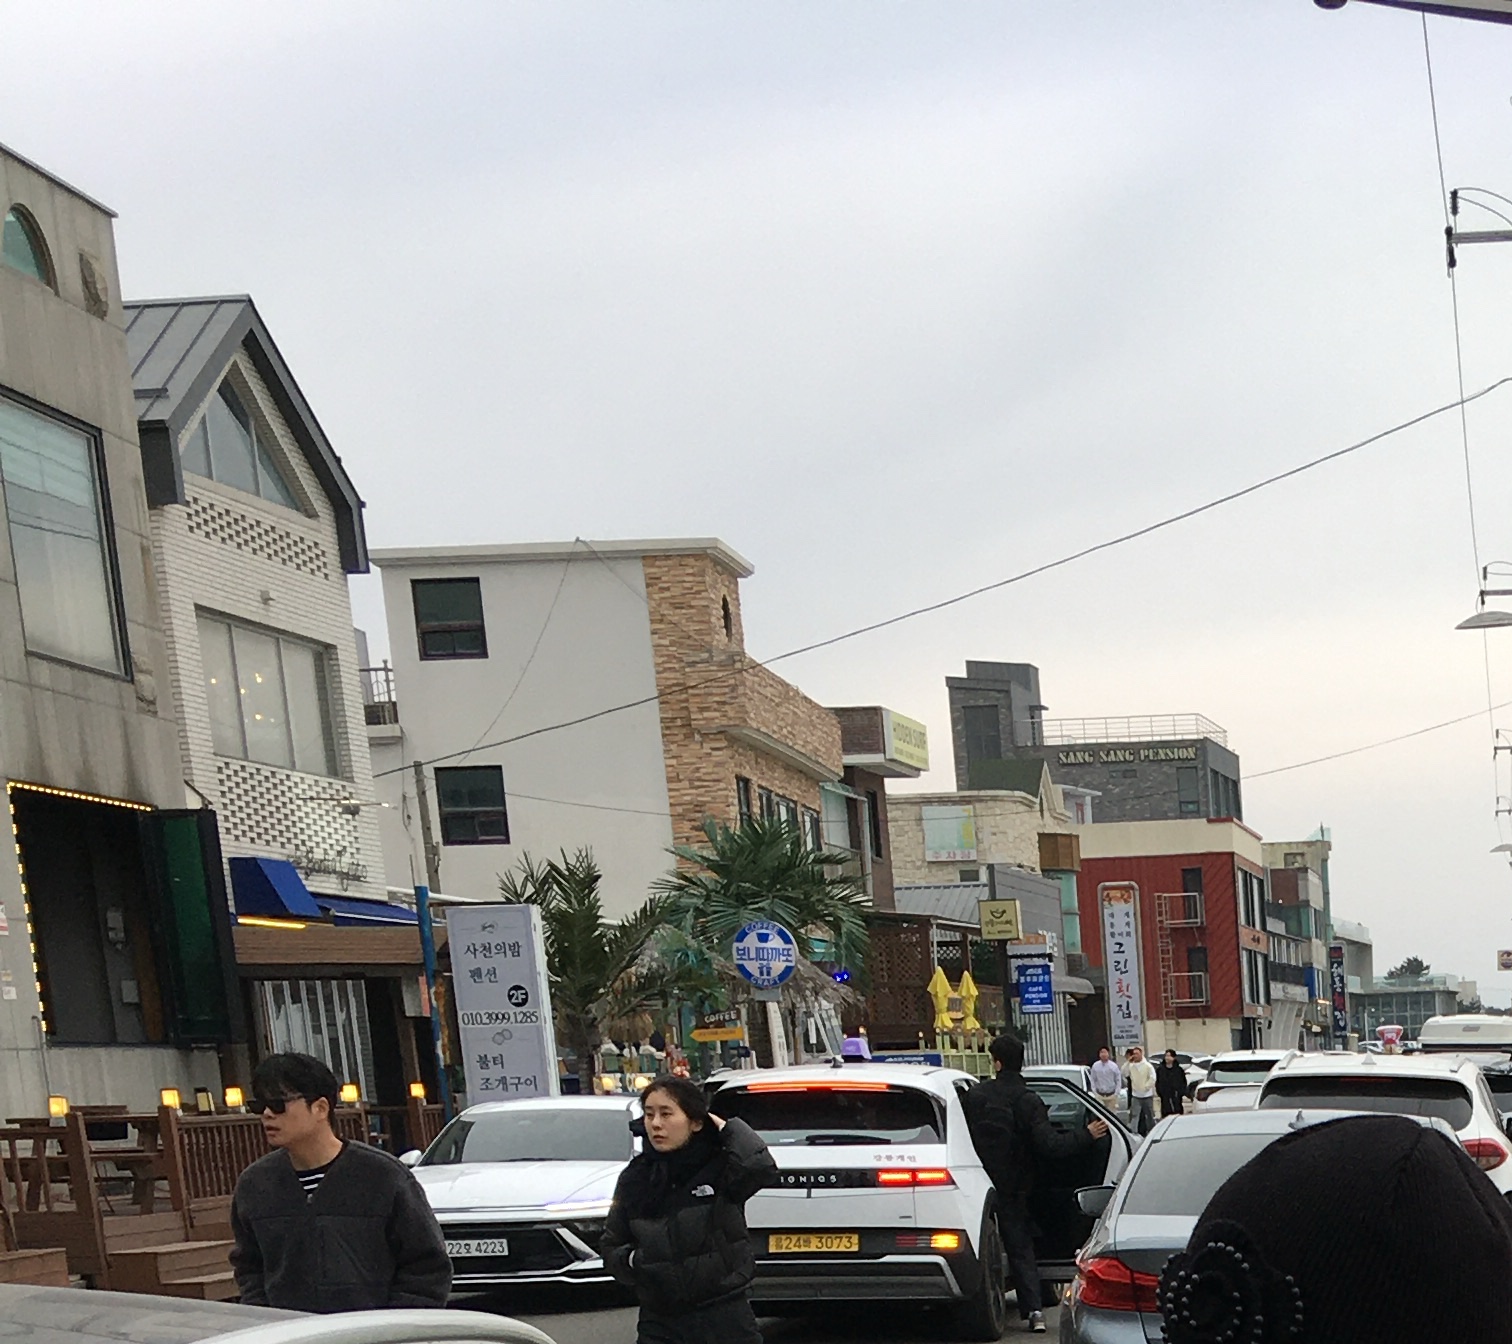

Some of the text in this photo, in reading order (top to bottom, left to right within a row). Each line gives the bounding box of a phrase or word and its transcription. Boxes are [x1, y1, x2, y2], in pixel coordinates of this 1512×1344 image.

[1059, 747, 1196, 764] SANG SANG PENSION
[745, 922, 780, 934] COFFEE
[463, 941, 522, 959] 사천의밤
[468, 966, 499, 984] 펜션
[1113, 942, 1133, 1019] 그린횟집
[509, 990, 527, 1003] 2F
[461, 1010, 539, 1026] 010.3999.1285
[704, 1010, 737, 1023] COFFEE
[479, 1075, 539, 1092] 조개구이
[475, 1241, 504, 1253] 4223
[815, 1236, 853, 1249] 3073
